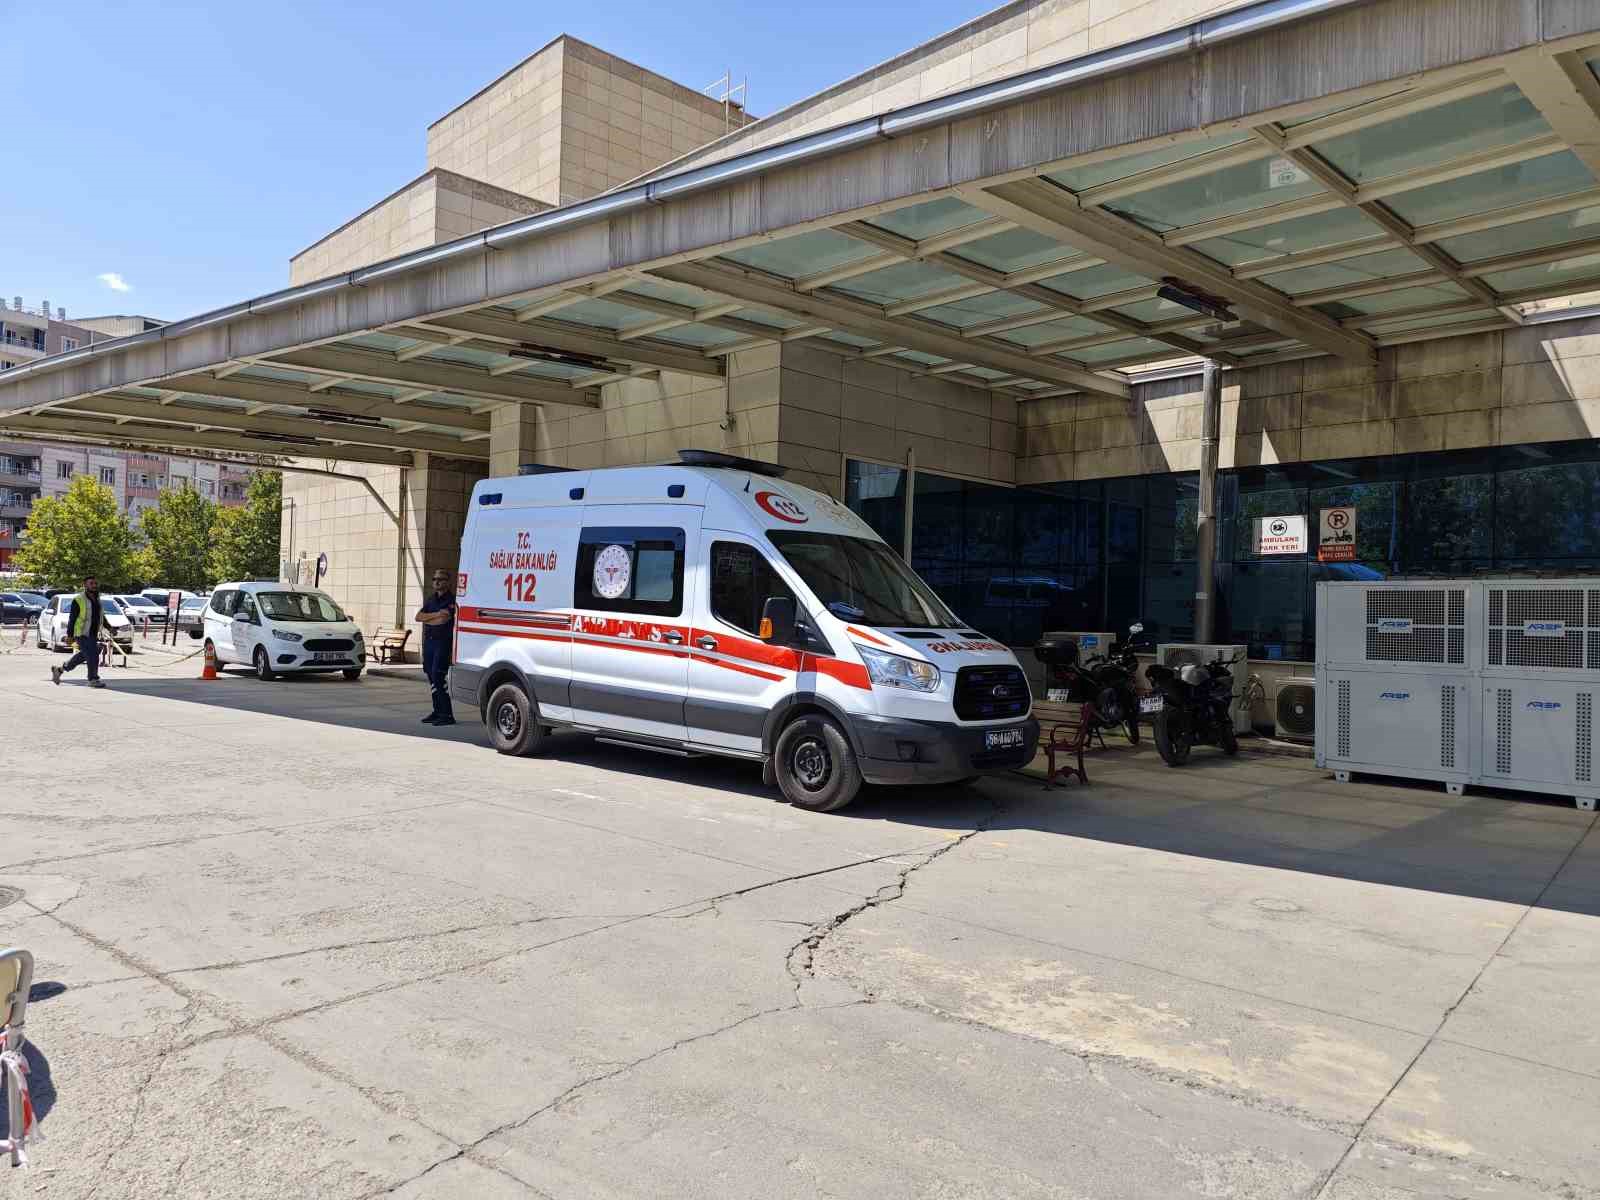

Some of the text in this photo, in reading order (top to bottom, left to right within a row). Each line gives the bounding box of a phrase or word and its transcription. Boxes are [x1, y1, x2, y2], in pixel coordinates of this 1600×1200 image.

[503, 573, 537, 602] 112
[1527, 623, 1562, 631] AREP
[1526, 701, 1561, 709] AREP
